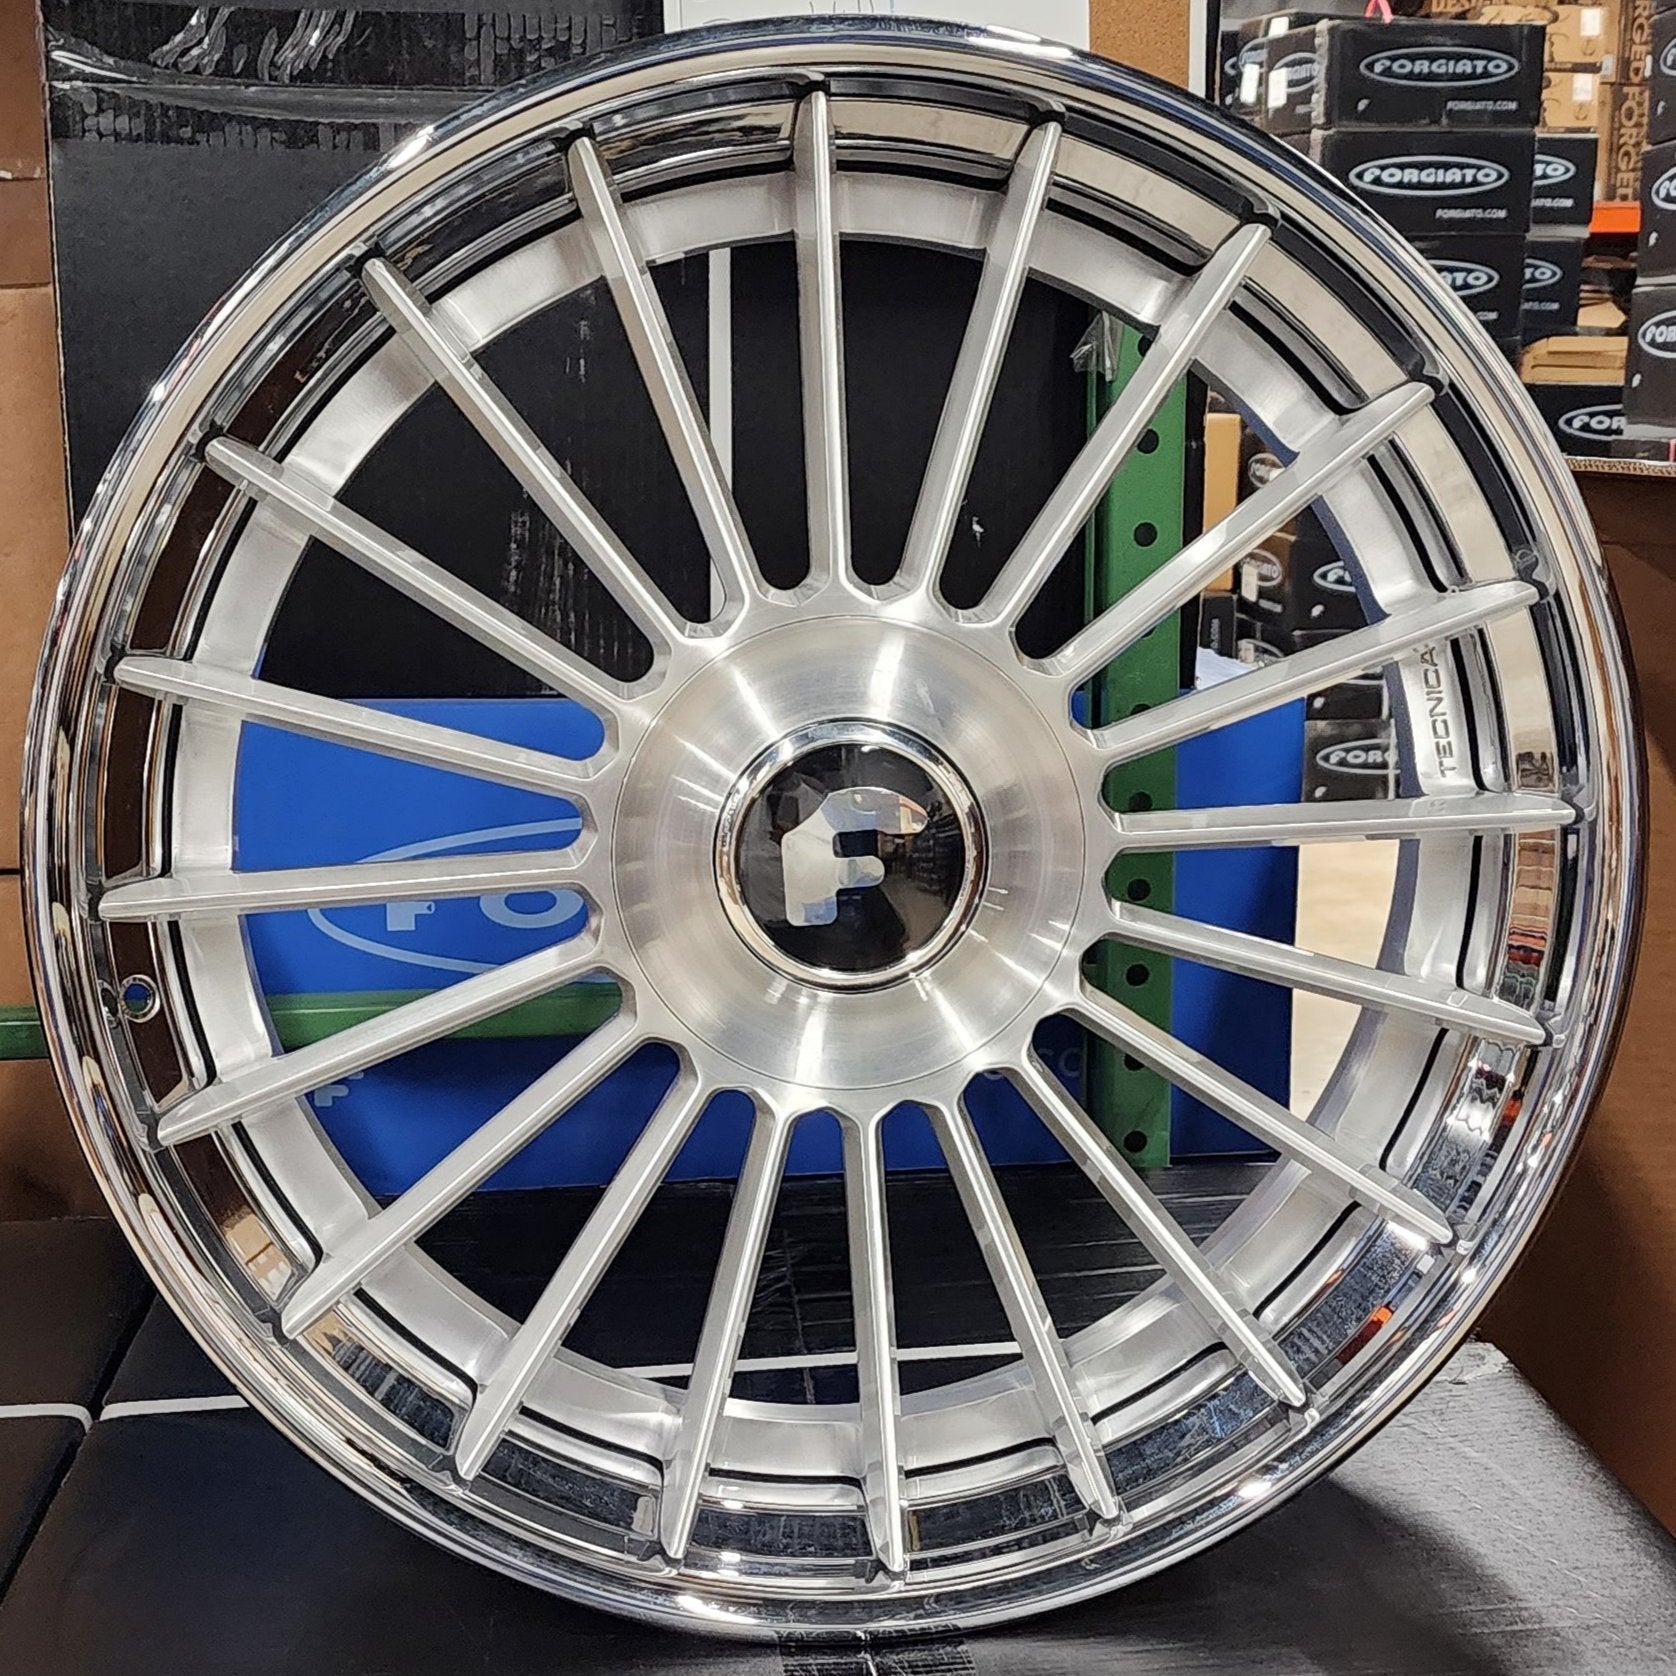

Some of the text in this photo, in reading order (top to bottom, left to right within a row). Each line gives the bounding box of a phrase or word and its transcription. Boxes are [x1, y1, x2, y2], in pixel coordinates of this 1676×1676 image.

[1373, 58, 1509, 75] FORGIATO
[1446, 100, 1519, 111] FORGIATO.COM
[1362, 168, 1499, 184] FORGIATO
[1435, 208, 1508, 219] FORGIATO.COM
[1420, 646, 1458, 778] TECNICA
